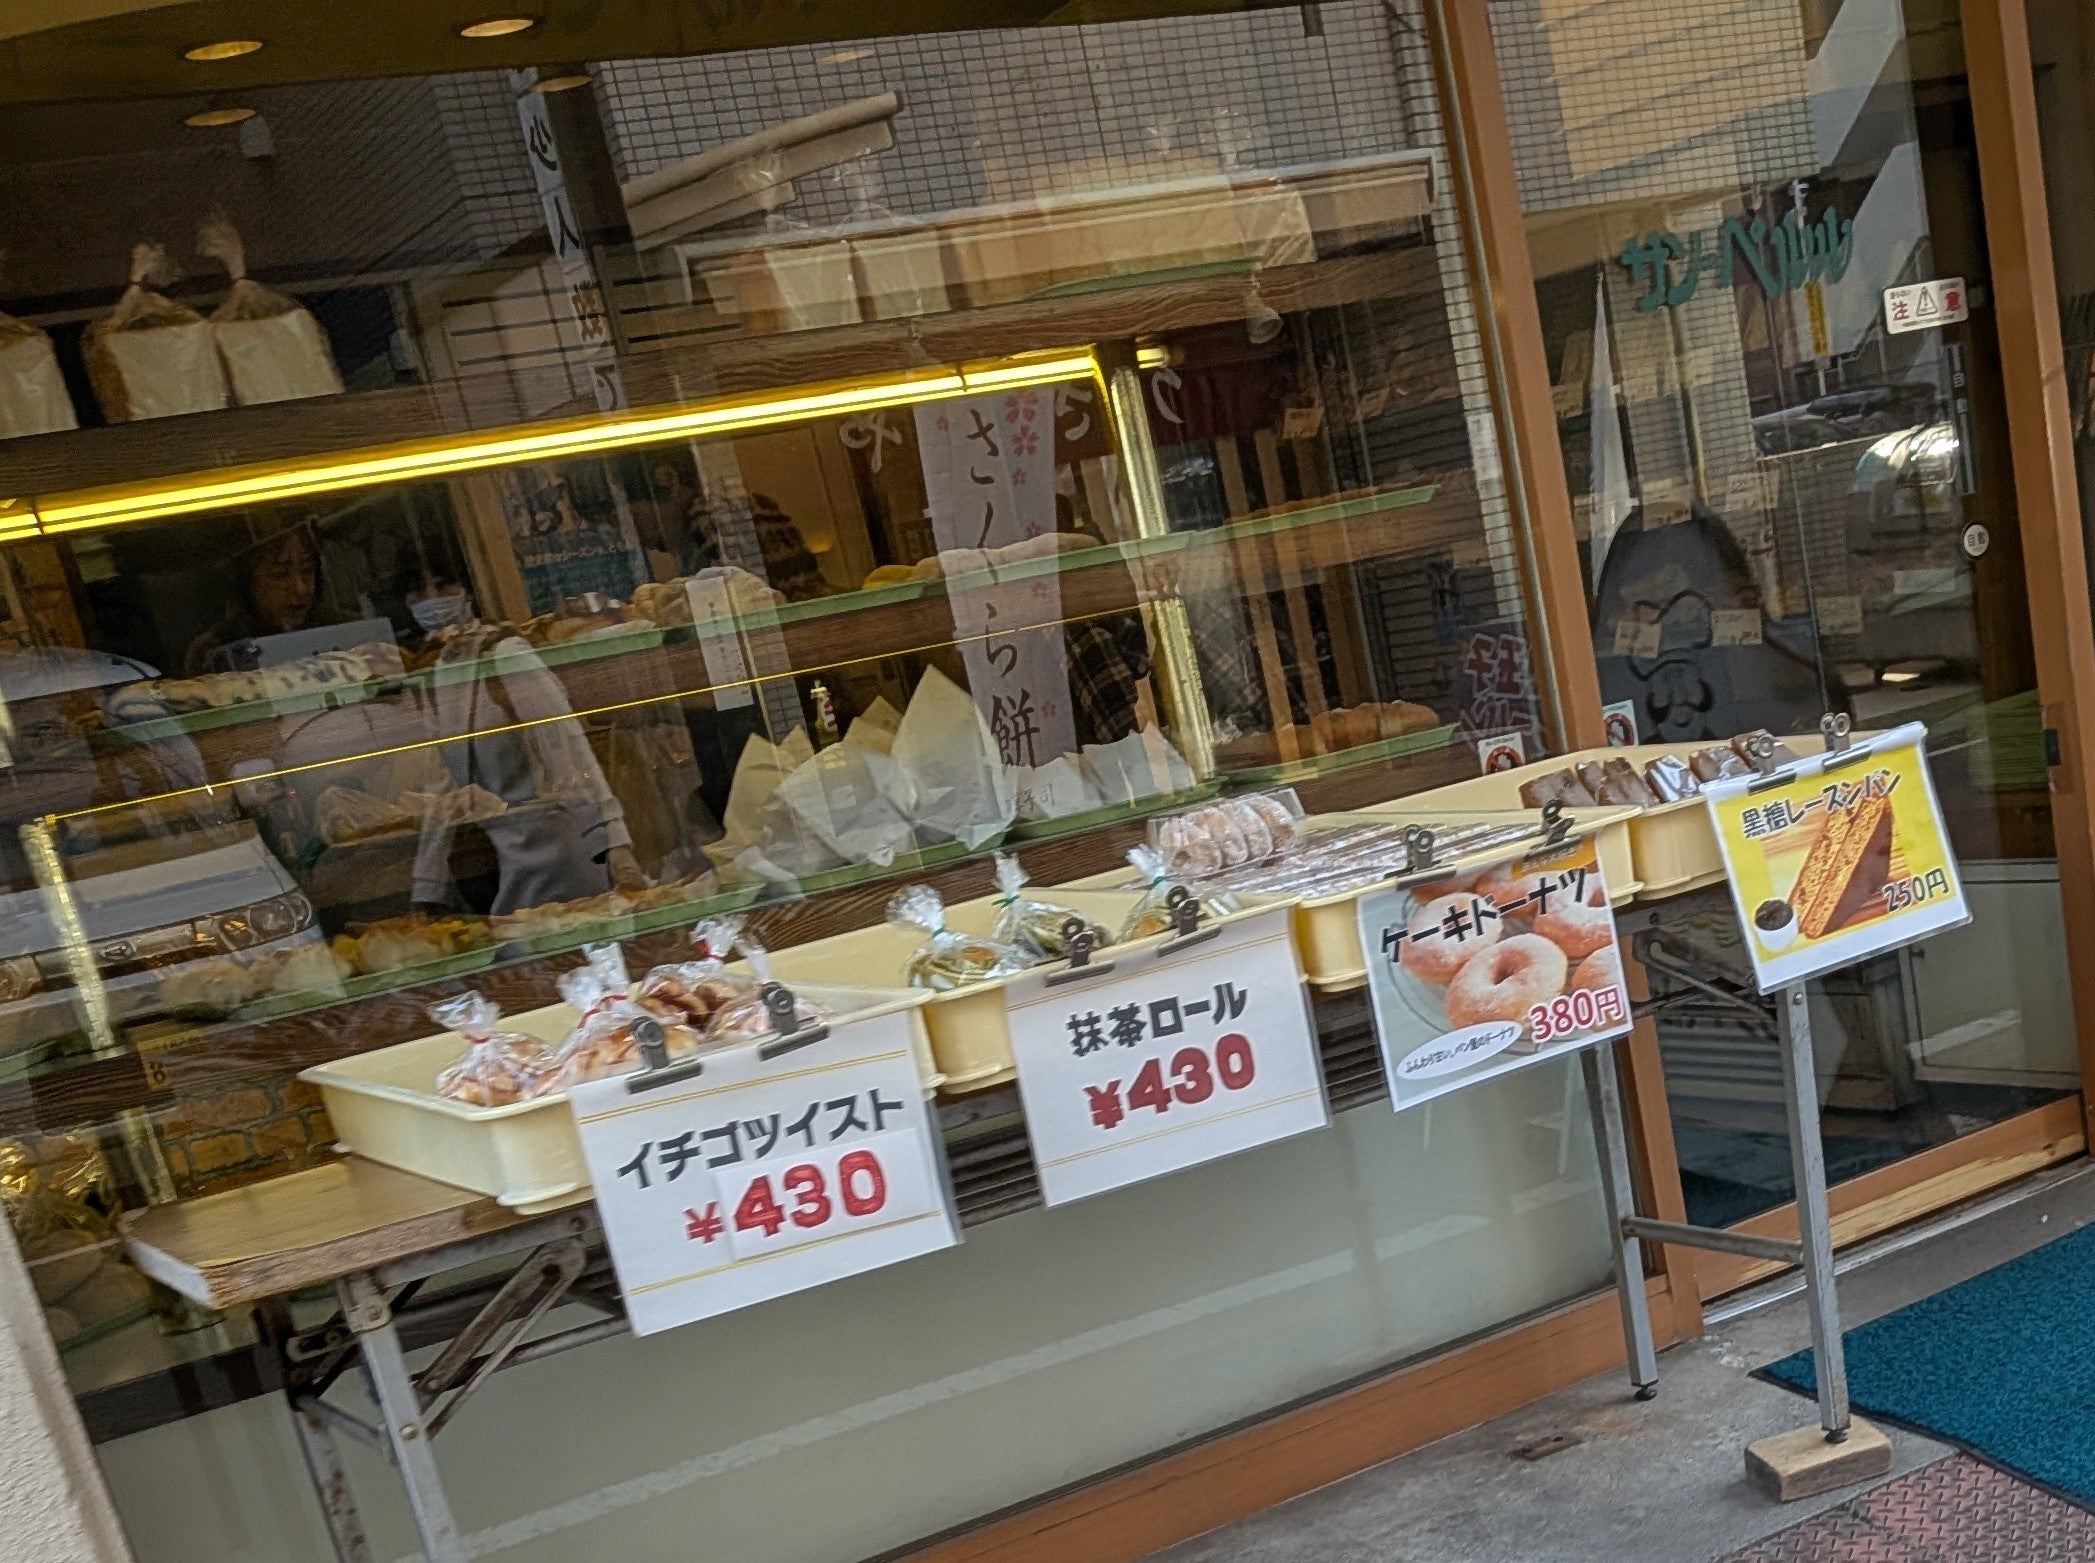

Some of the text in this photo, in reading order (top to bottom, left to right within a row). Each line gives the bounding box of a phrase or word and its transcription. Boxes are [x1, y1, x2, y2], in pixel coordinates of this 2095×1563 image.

[966, 407, 1042, 769] さくら餅
[1381, 867, 1586, 963] ケーキドーナツ
[1883, 866, 1951, 912] 250円
[1066, 982, 1248, 1057] 抹茶ロール
[1530, 984, 1625, 1042] 380円
[1083, 1033, 1256, 1130] ¥430
[615, 1087, 904, 1189] イチゴツイスト
[682, 1149, 888, 1244] ¥430
